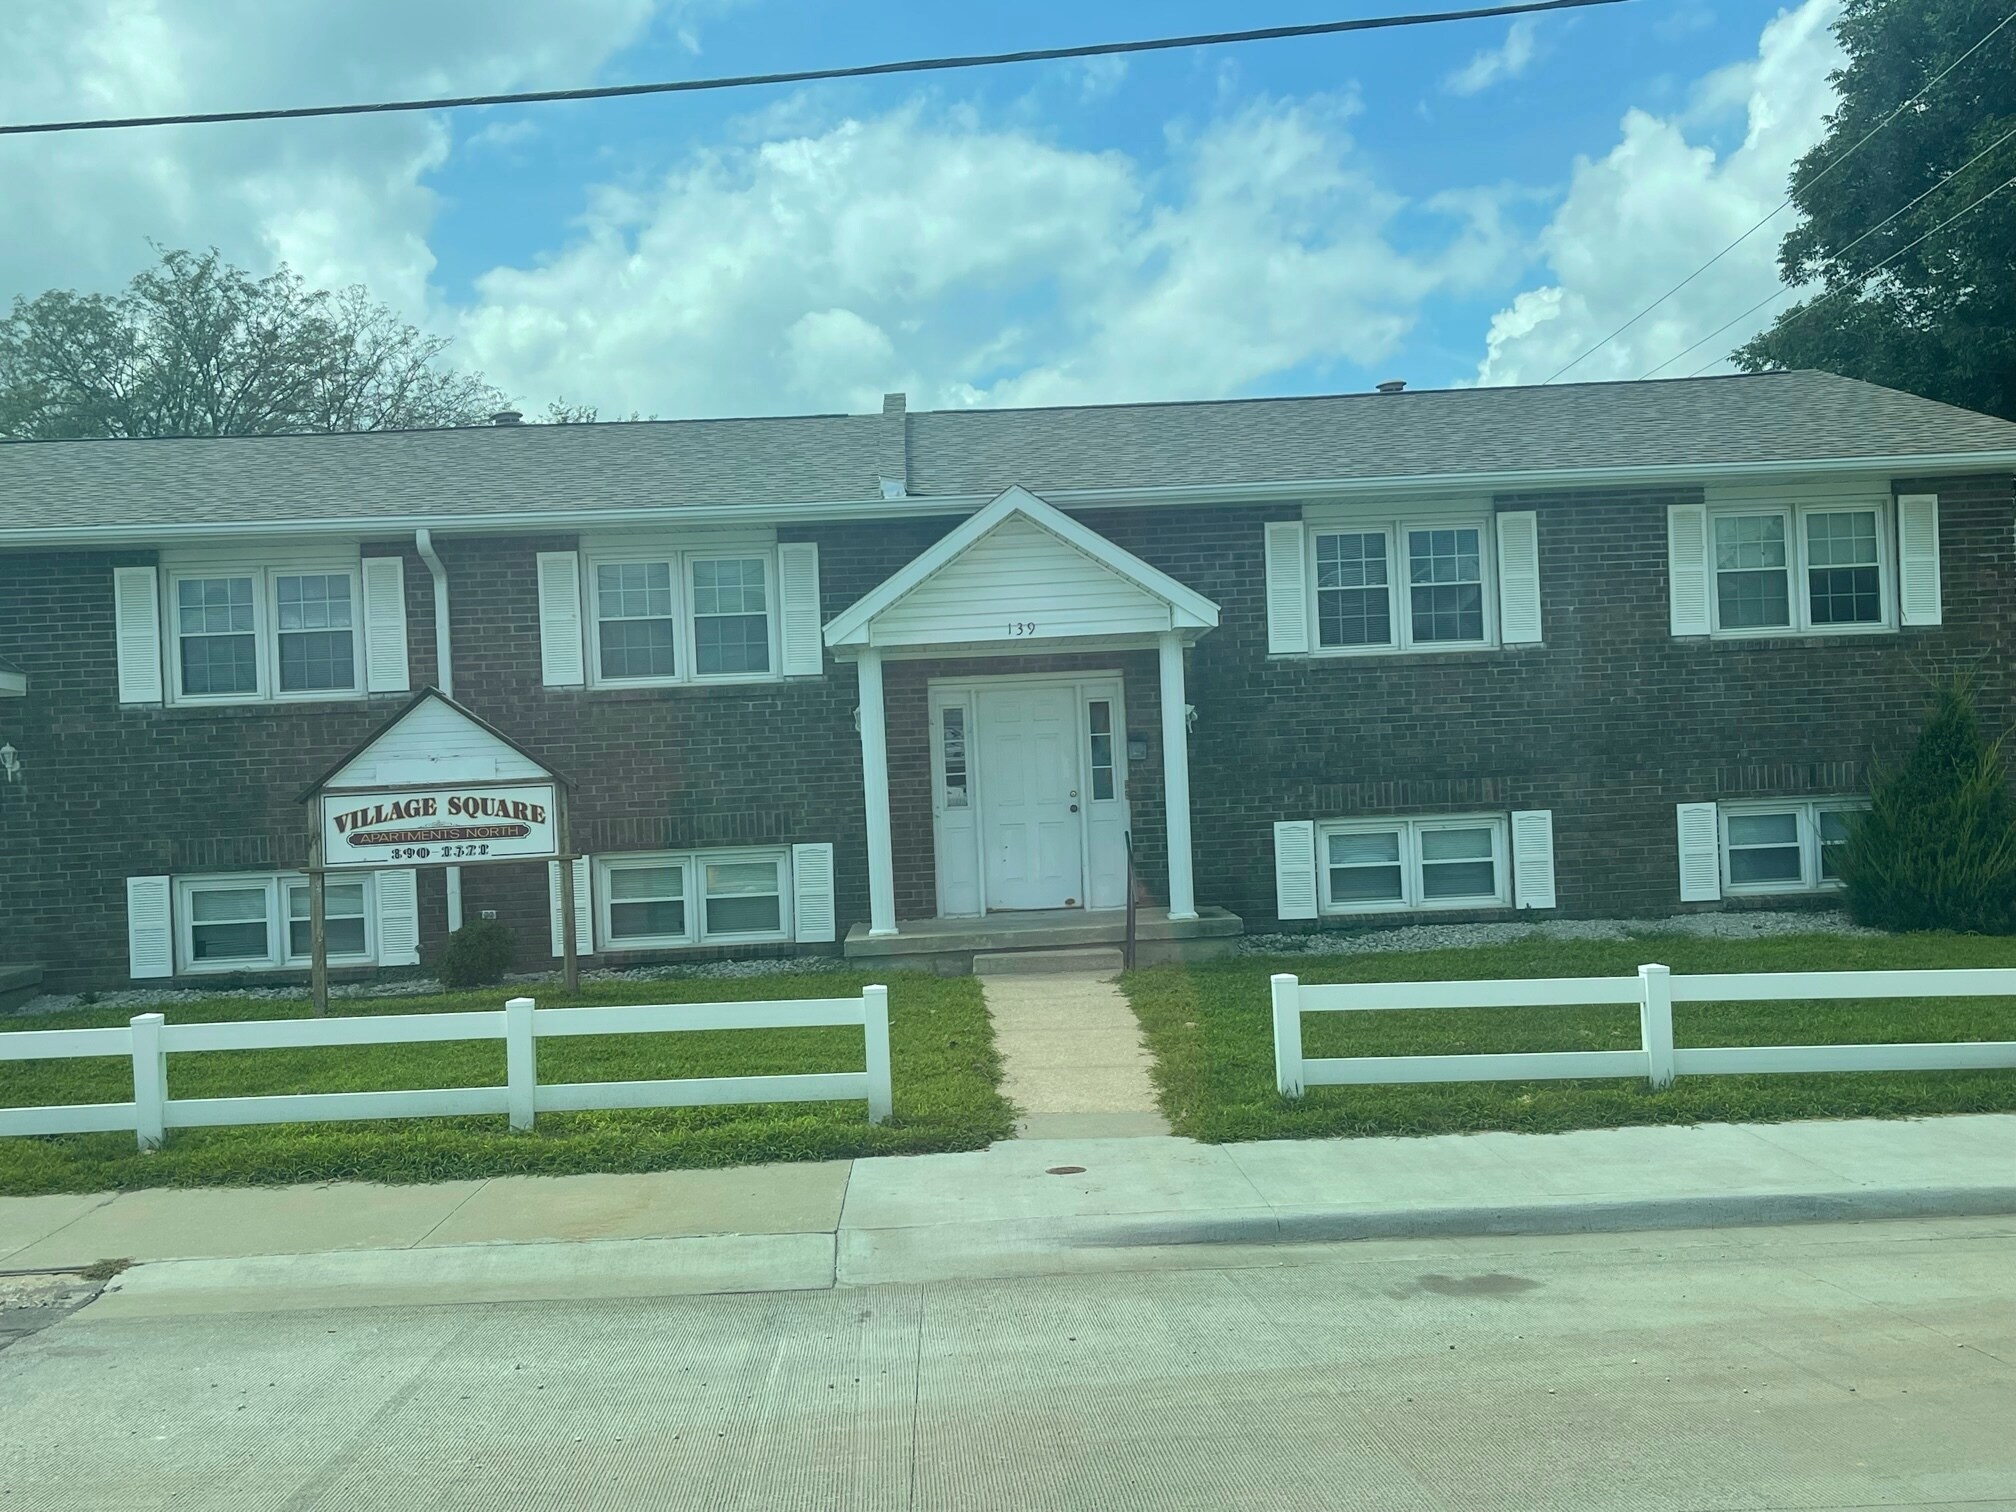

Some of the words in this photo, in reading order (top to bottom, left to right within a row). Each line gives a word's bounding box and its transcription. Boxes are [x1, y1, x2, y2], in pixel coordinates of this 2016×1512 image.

[1008, 622, 1035, 635] 139
[333, 797, 437, 833] VILLAGE
[448, 796, 547, 824] SQUARE
[360, 829, 460, 844] APARTMENTS
[466, 826, 519, 838] NORTH
